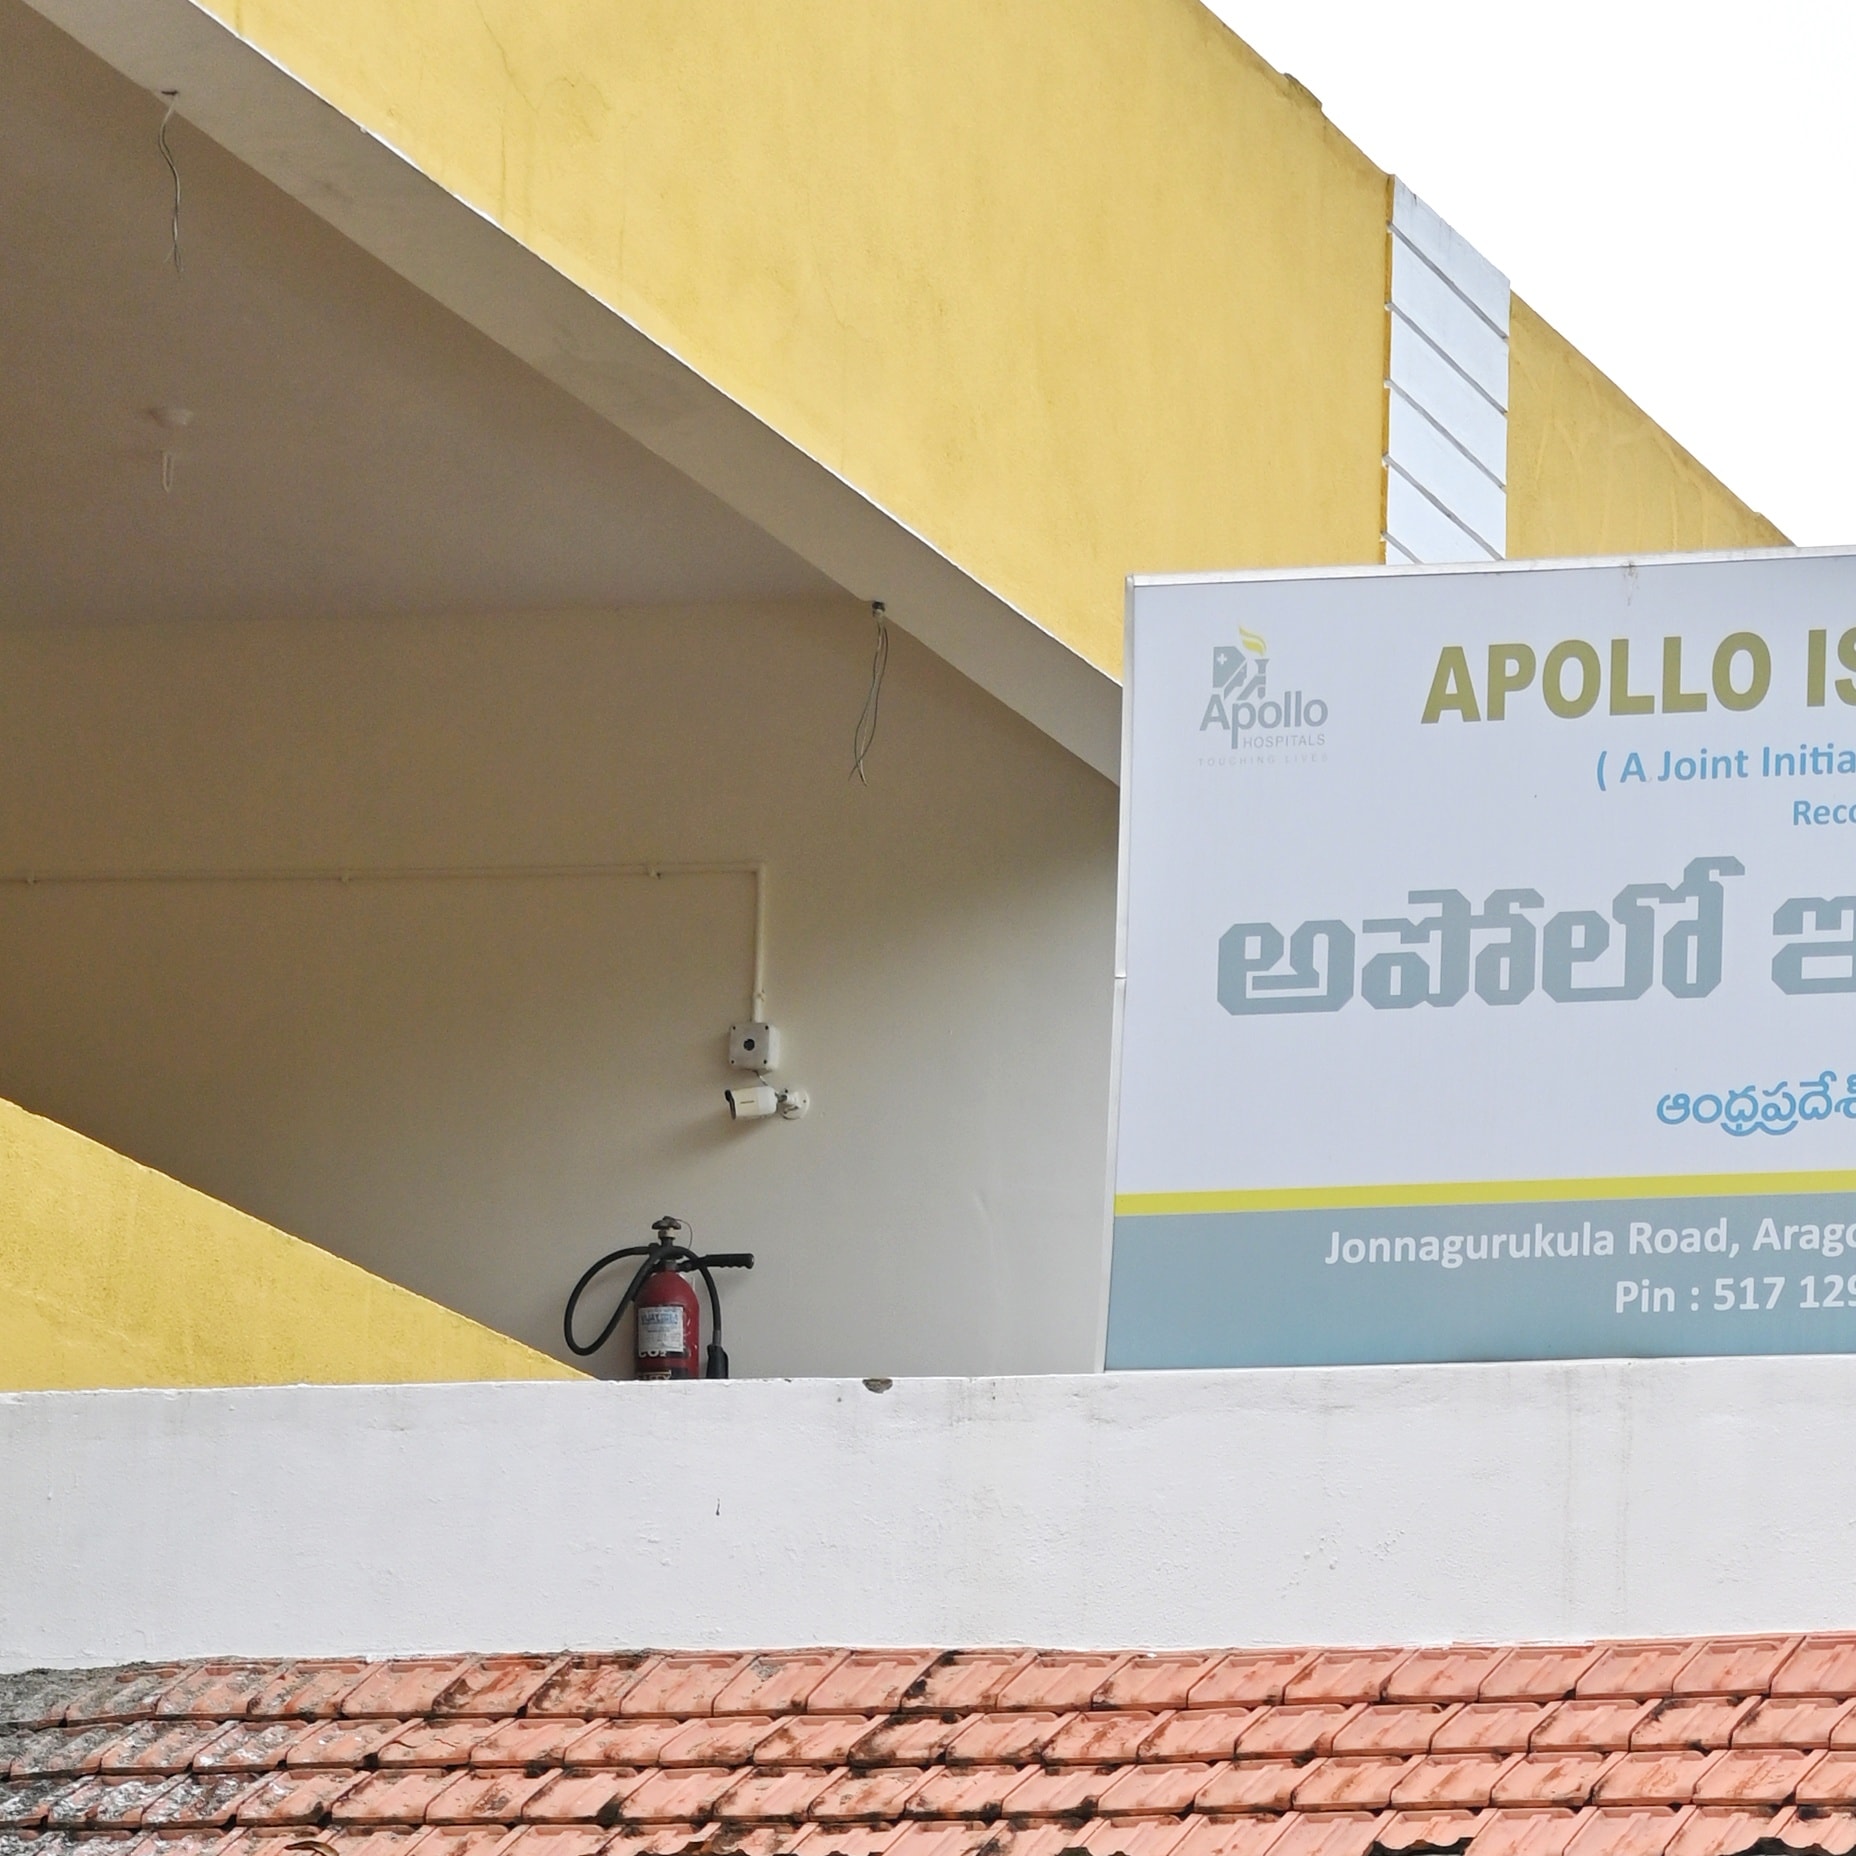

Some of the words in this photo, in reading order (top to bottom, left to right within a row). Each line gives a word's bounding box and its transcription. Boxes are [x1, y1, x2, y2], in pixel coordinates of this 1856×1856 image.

[1421, 632, 1771, 724] APOLLO
[1200, 690, 1328, 749] Apollo
[1243, 733, 1326, 749] HOSPITALS
[1620, 752, 1646, 783] A
[1658, 748, 1748, 781] Joint
[1217, 856, 1745, 1016] అపోలో
[1325, 1222, 1613, 1268] Jonnagurukula
[1629, 1217, 1739, 1258] Road,
[1616, 1279, 1674, 1313] Pin
[1714, 1277, 1785, 1310] 517
